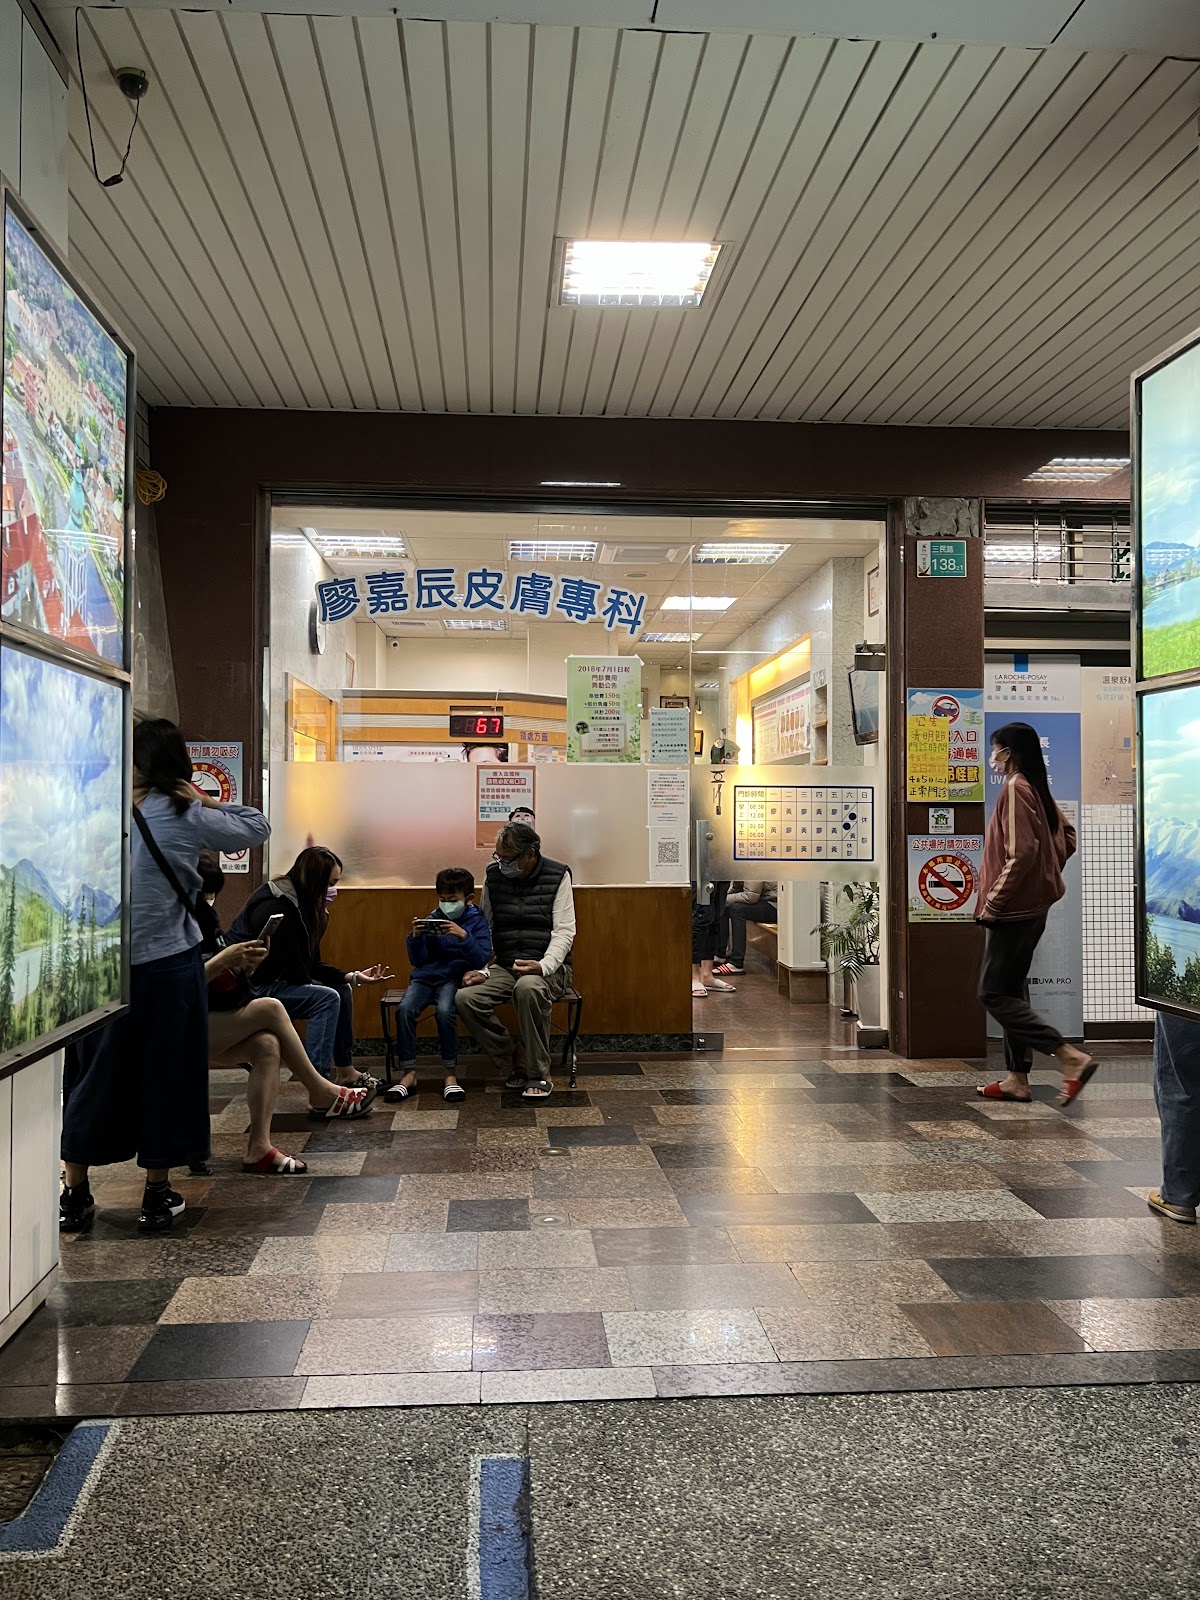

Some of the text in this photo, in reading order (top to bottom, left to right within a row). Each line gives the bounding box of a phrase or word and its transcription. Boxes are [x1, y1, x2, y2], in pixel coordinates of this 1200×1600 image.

[932, 545, 954, 553] 三民路
[318, 567, 645, 635] 廖嘉辰皮膚專科
[476, 718, 501, 734] 67
[911, 730, 946, 742] 清明節
[202, 746, 239, 758] 請勿吸菸
[908, 743, 947, 752] 門診時間
[909, 786, 948, 798] 正常門診
[912, 839, 980, 850] 公共場所 請勿吸菸
